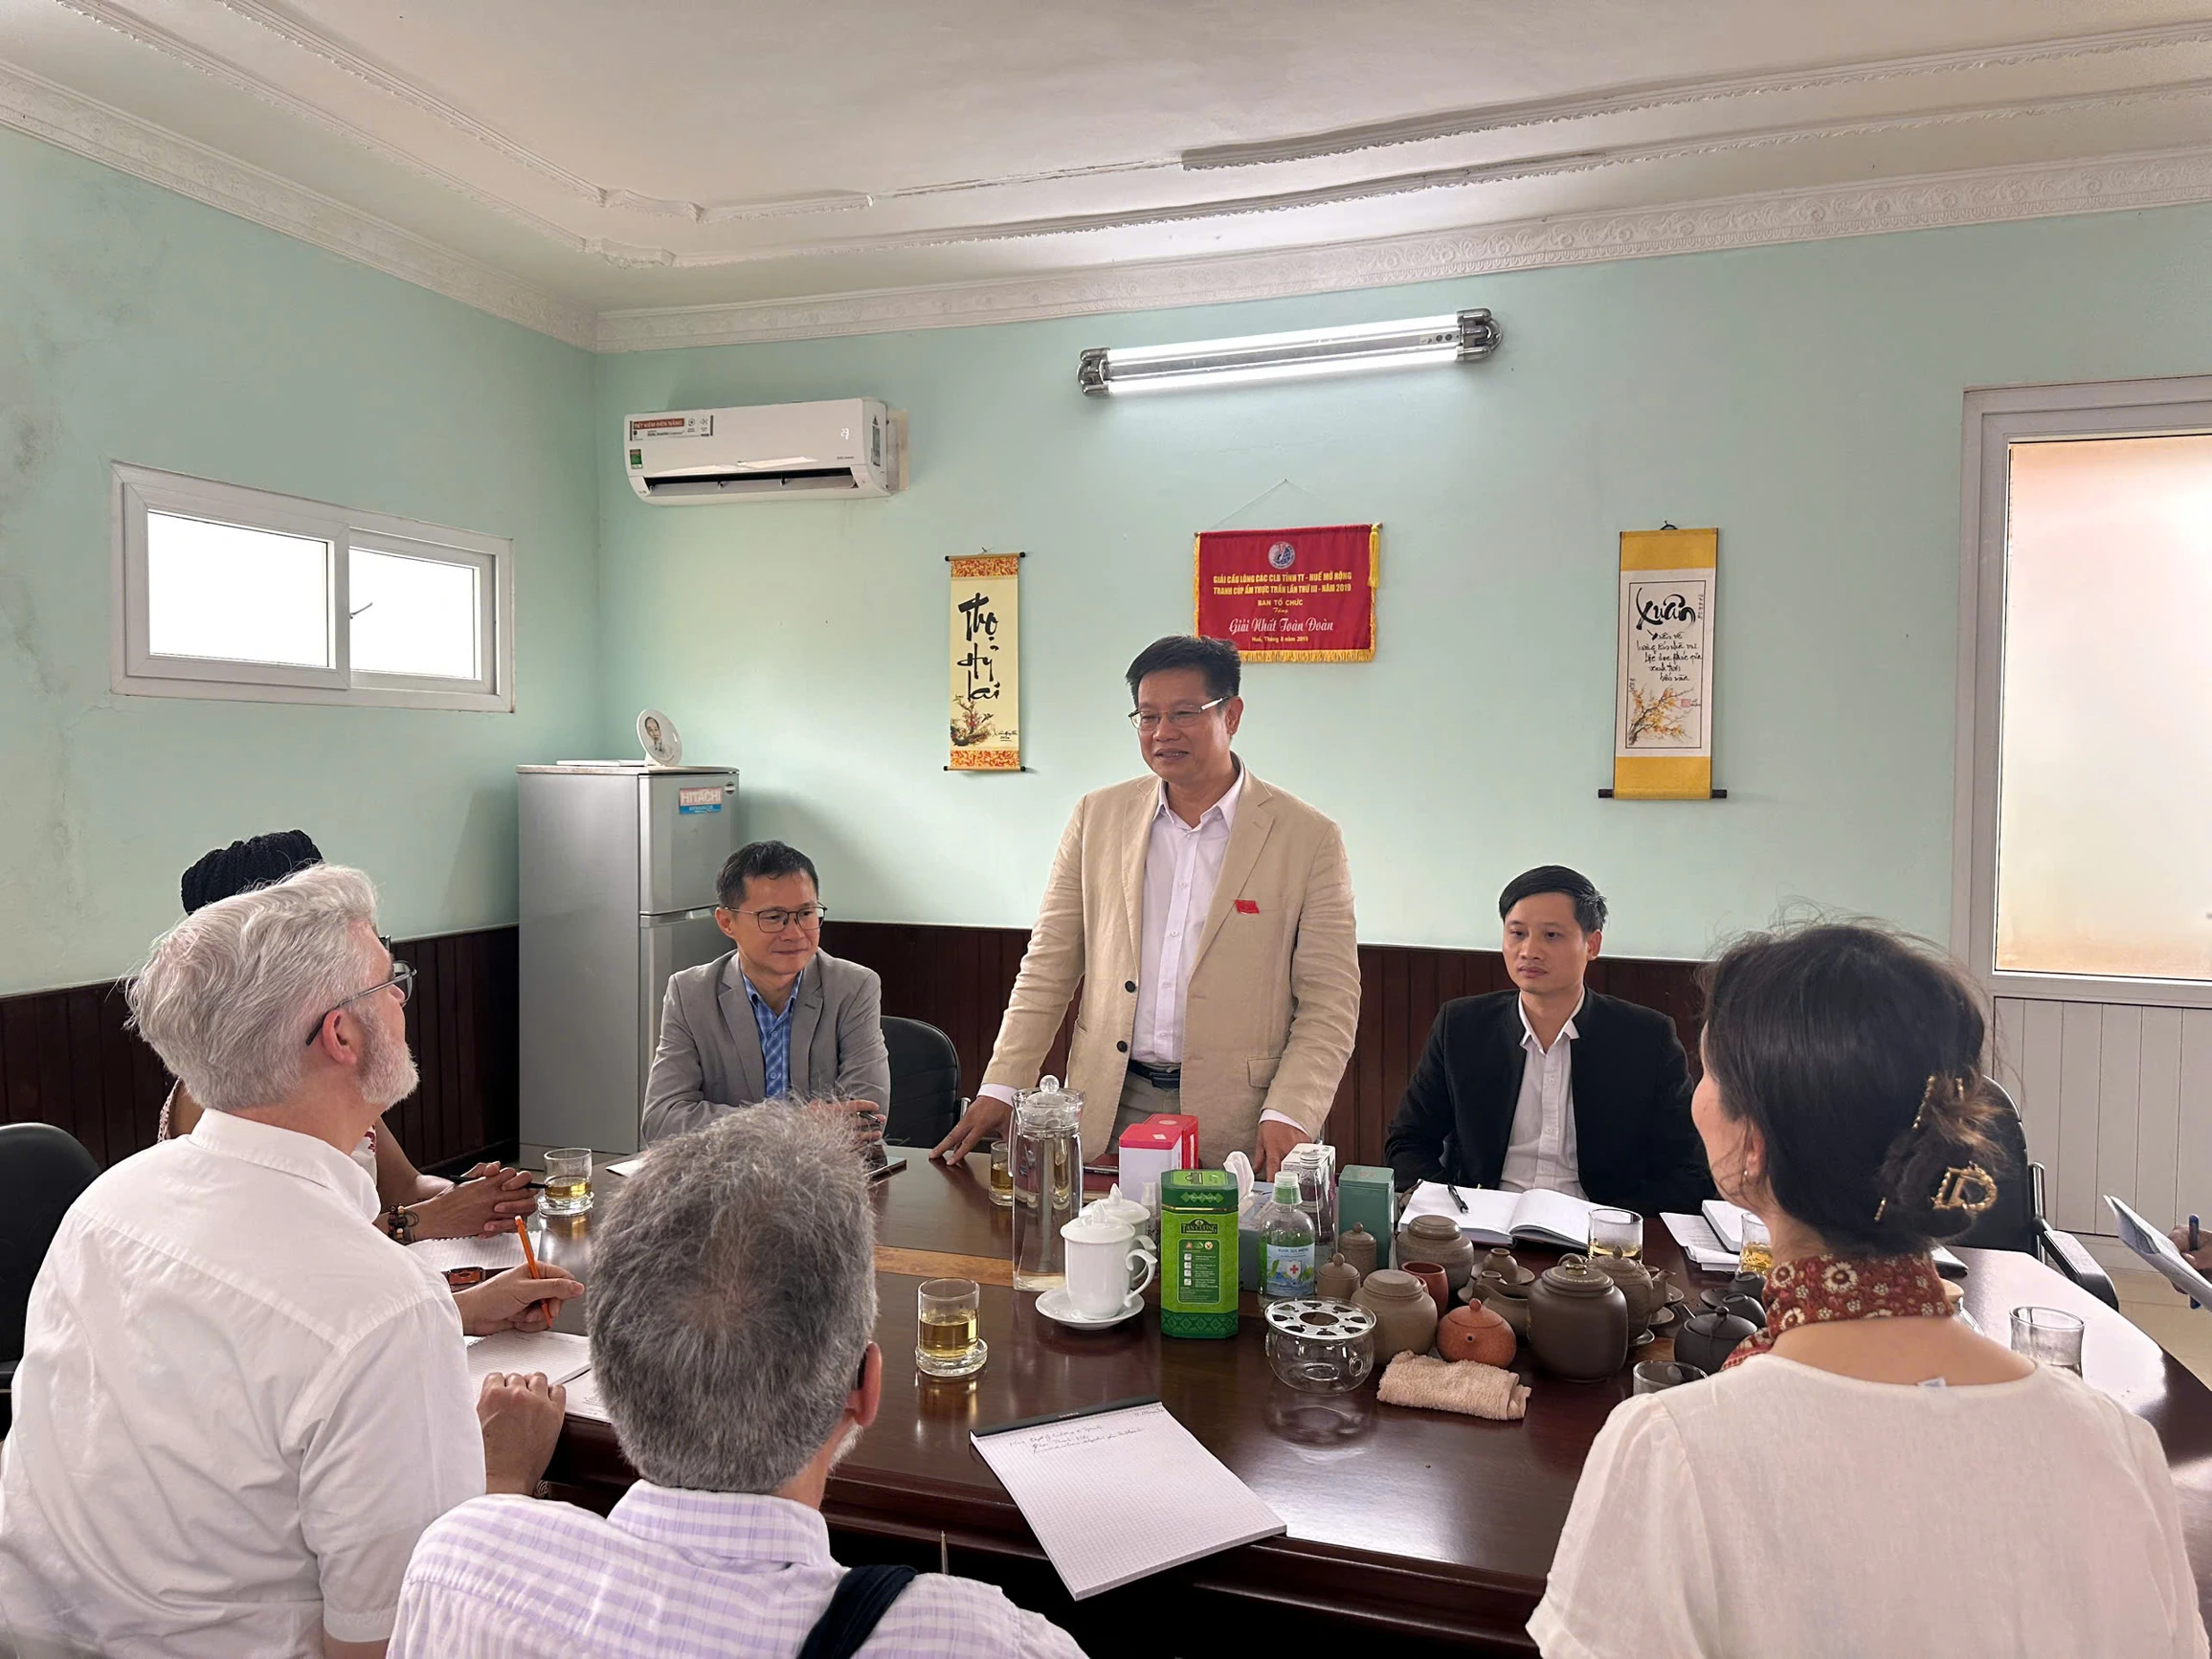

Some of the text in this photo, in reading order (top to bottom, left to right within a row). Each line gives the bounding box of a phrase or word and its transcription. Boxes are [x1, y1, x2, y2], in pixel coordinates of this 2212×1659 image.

[1269, 573, 1281, 582] CLB
[1298, 573, 1305, 582] TT
[1309, 571, 1323, 581] HUẾ
[1636, 587, 1696, 631] Xuân
[1229, 617, 1333, 636] Giải Nhất Toàn Đoàn
[681, 791, 722, 803] HITACHI
